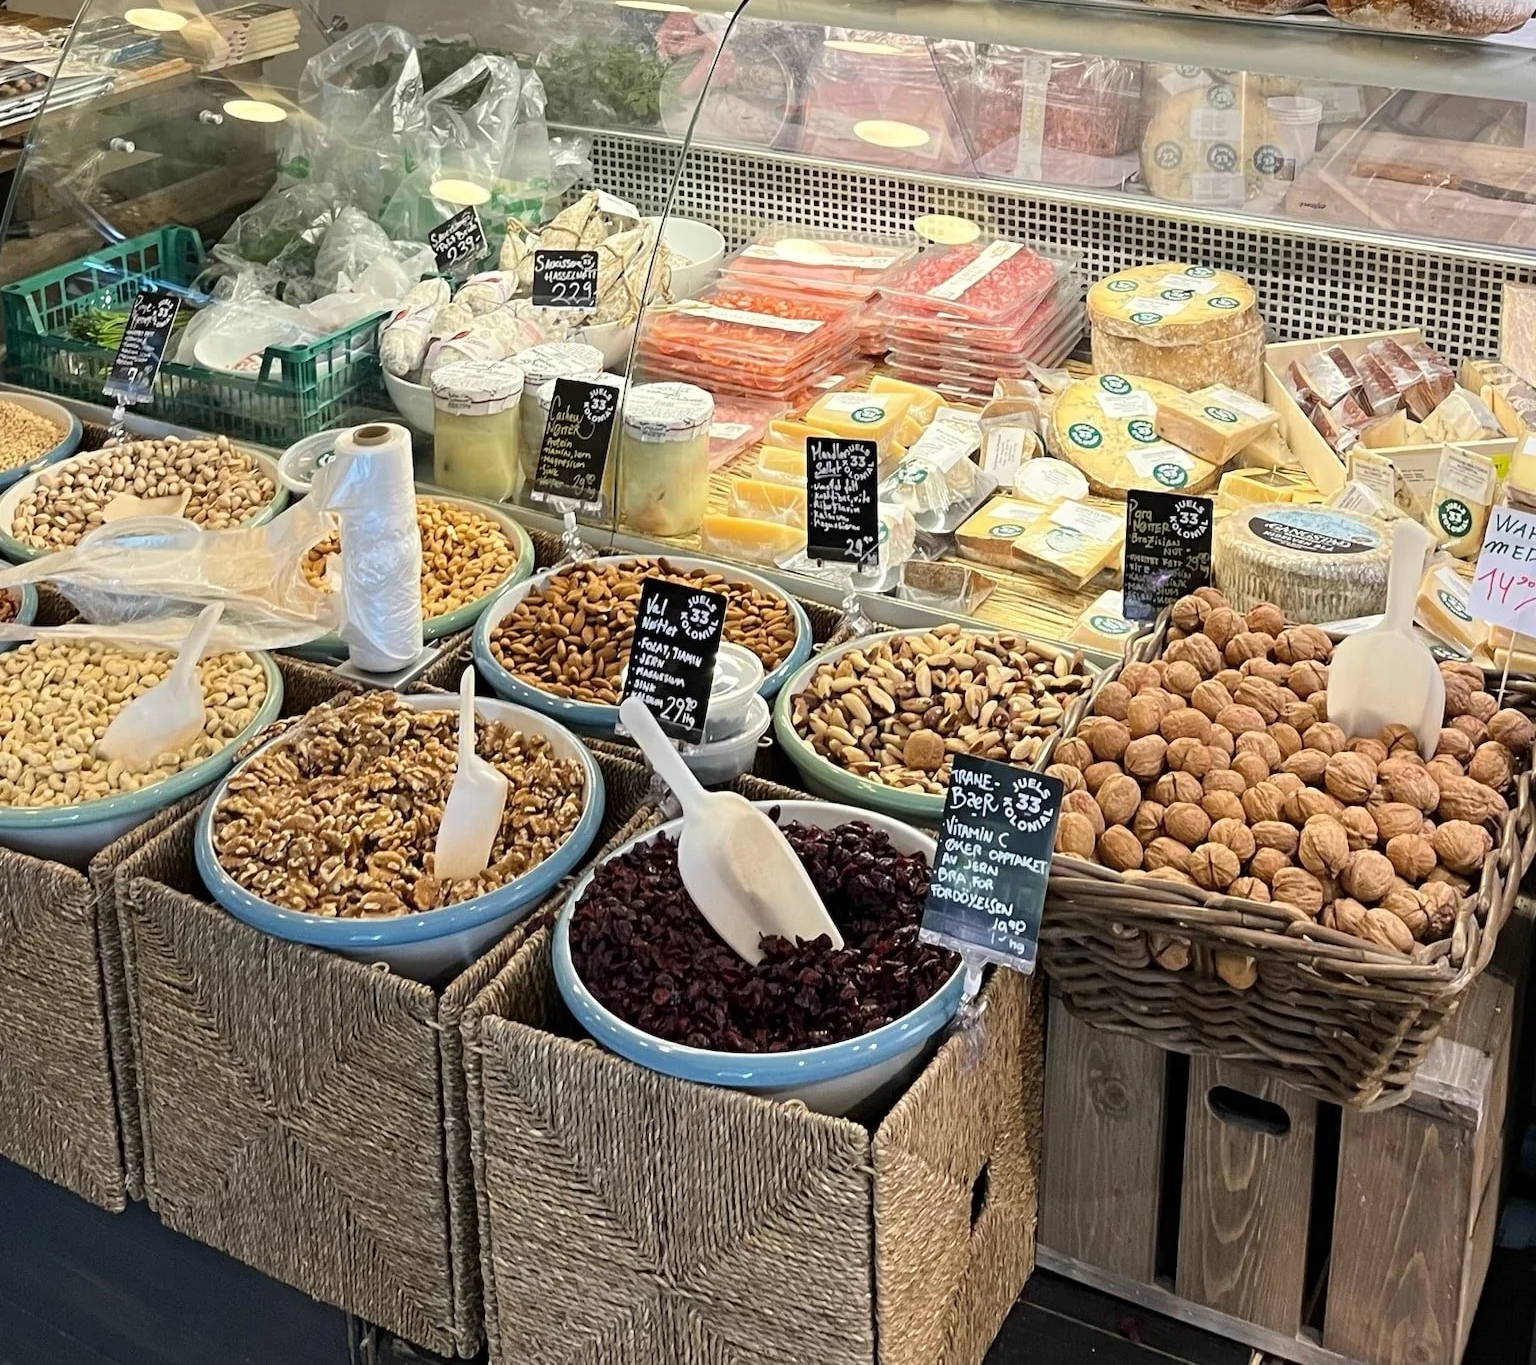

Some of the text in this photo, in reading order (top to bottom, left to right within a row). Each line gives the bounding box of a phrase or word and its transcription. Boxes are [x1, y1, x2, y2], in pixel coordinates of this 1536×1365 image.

[591, 398, 607, 410] 33
[1175, 500, 1205, 515] JUELS
[1170, 516, 1209, 539] KOLONIAL
[1180, 512, 1199, 525] 33
[688, 595, 717, 614] JUELS
[680, 611, 719, 641] KOLONIAL
[690, 608, 710, 625] 33
[639, 652, 666, 668] JERN
[951, 769, 1000, 791] TRANE-
[1012, 777, 1051, 800] JUELS
[1015, 793, 1042, 814] 33
[1003, 797, 1053, 833] KOLONIAL
[998, 832, 1010, 849] C
[941, 853, 999, 877] AV JERN
[945, 838, 1048, 875] ØKER OPPTAKET
[937, 868, 994, 891] BRA FOR
